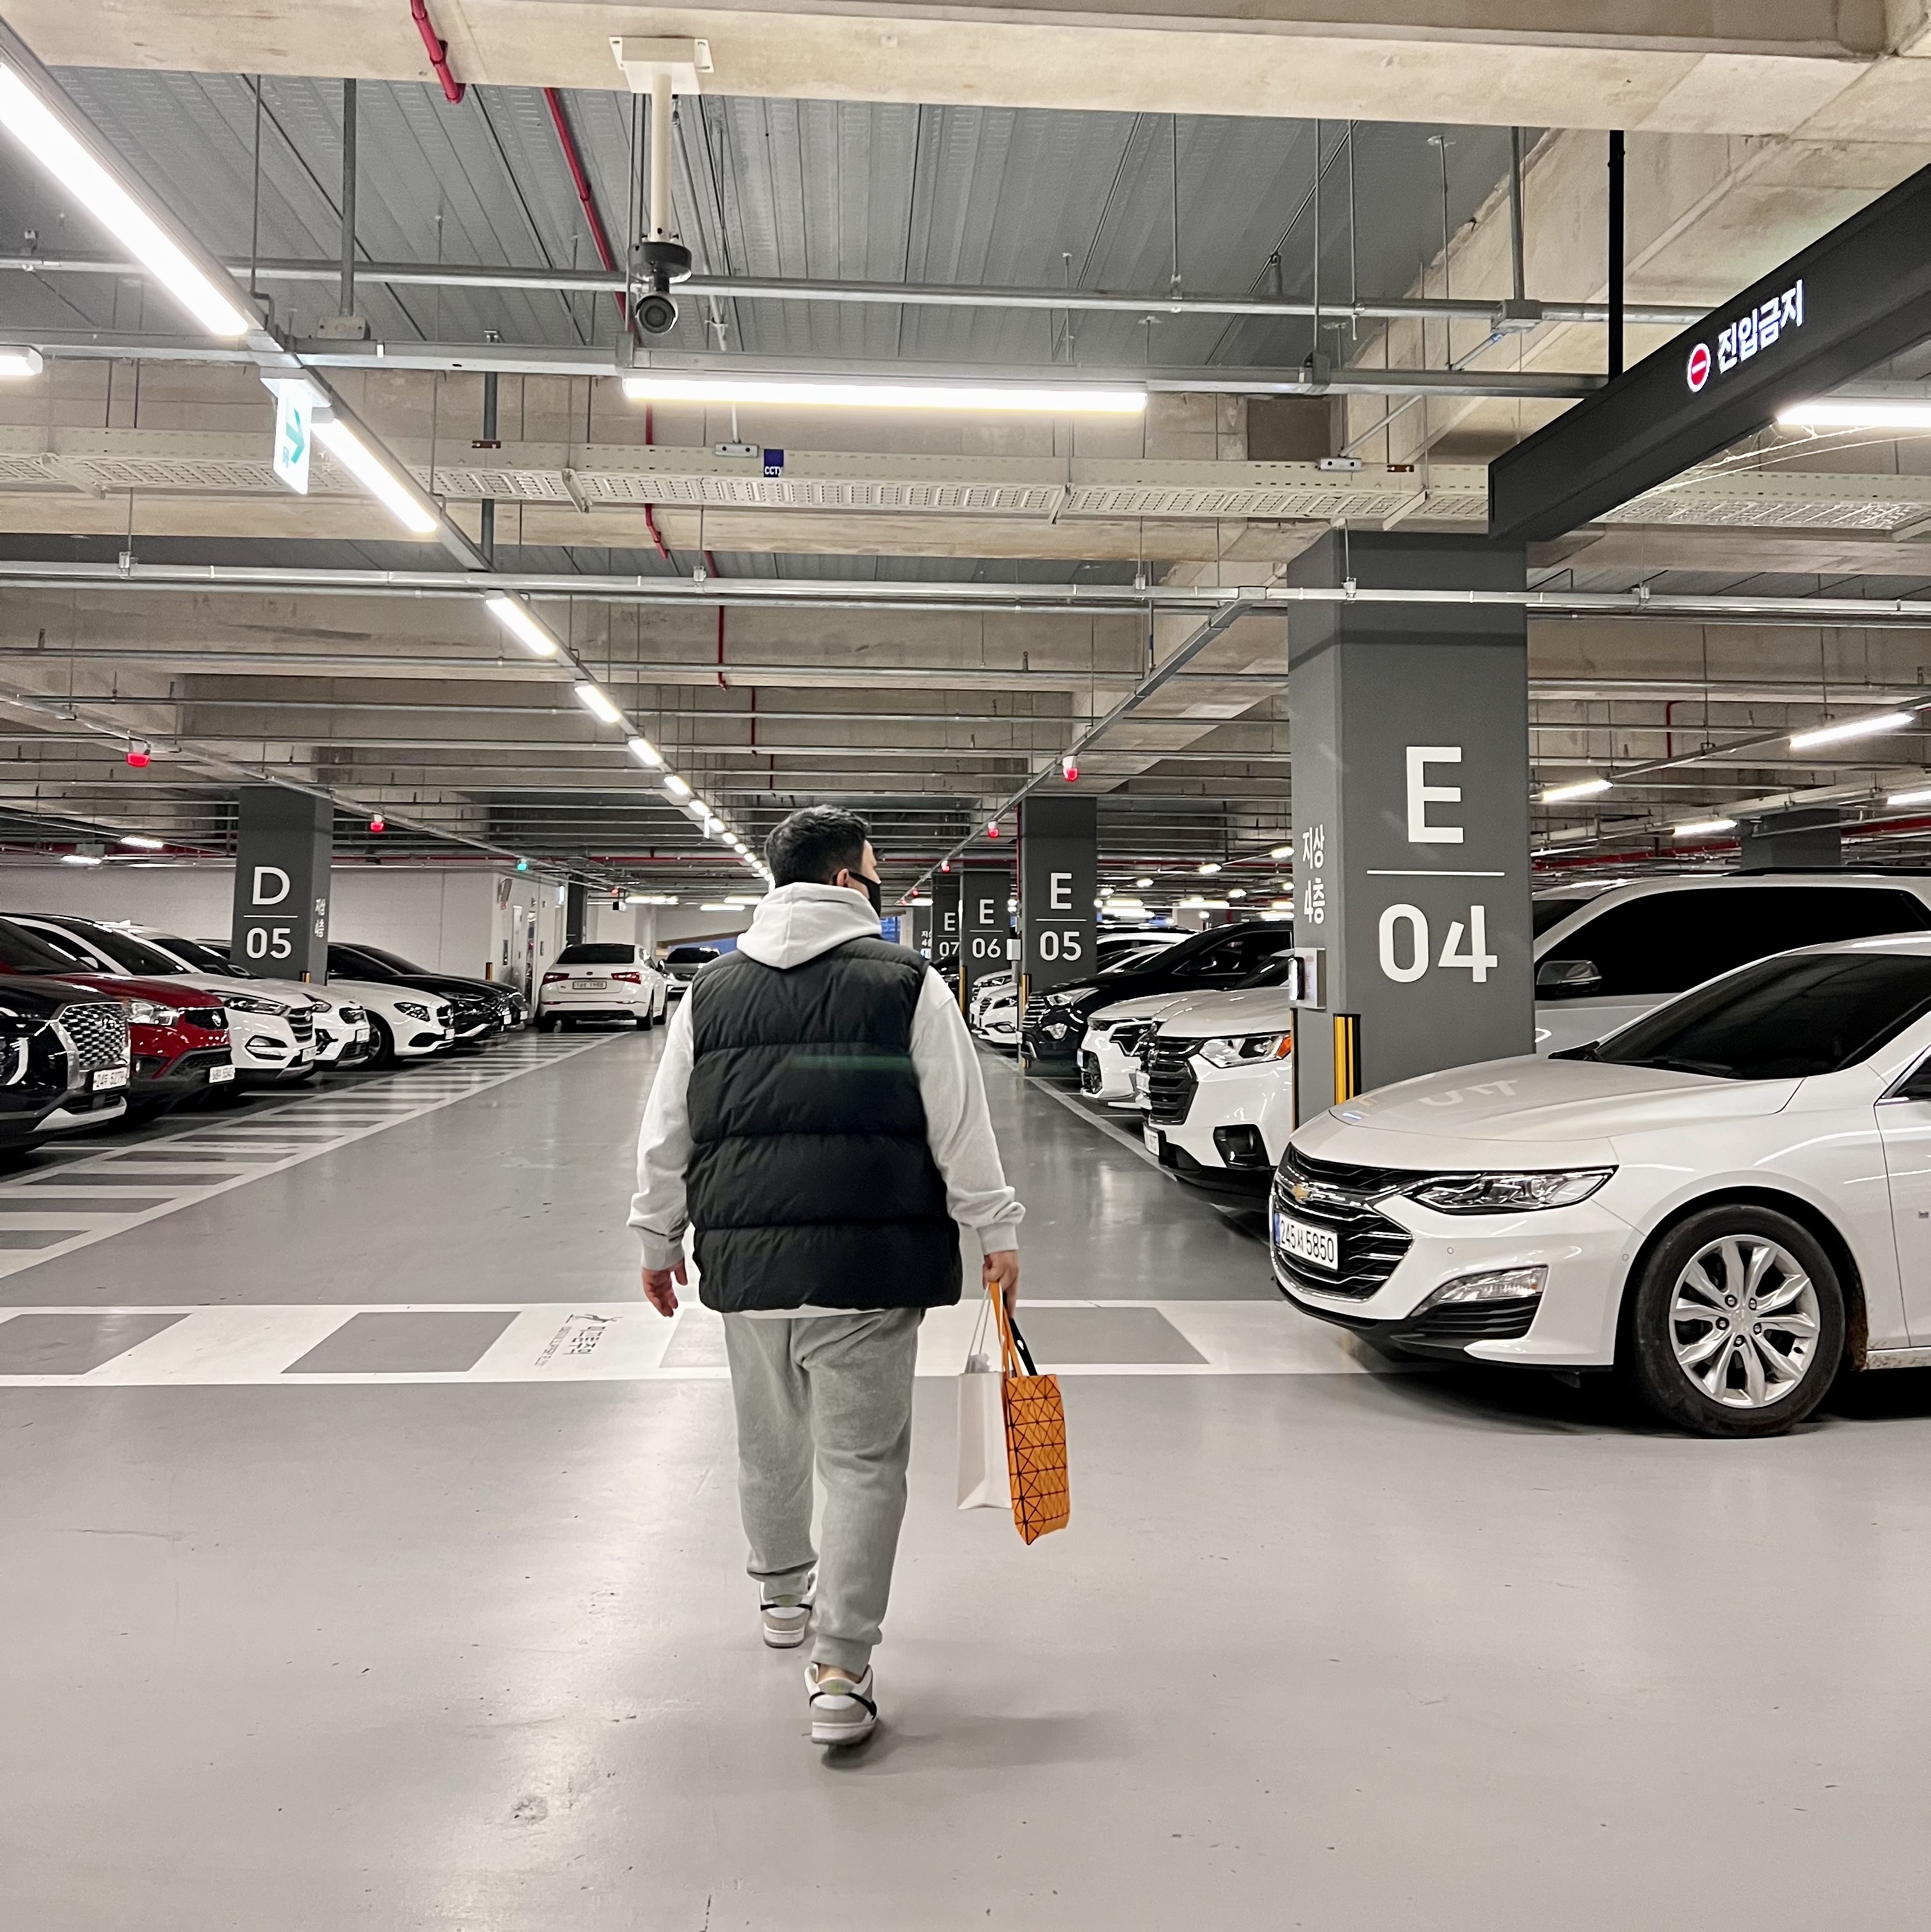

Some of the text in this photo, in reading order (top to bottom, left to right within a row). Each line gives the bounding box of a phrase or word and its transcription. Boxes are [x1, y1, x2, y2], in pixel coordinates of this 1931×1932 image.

[1716, 278, 1805, 374] 진입금지
[764, 466, 784, 476] CCTV
[1406, 746, 1464, 844] E
[1302, 824, 1325, 869] 지상
[252, 866, 290, 905] D
[1050, 872, 1072, 909] E
[1303, 877, 1326, 924] 4층
[944, 912, 956, 931] E
[980, 899, 994, 924] E
[246, 927, 291, 959] 05
[939, 941, 959, 957] 07
[972, 938, 1001, 958] 06
[1040, 931, 1082, 961] 05
[1379, 904, 1498, 983] 04
[1306, 1231, 1334, 1263] 5850
